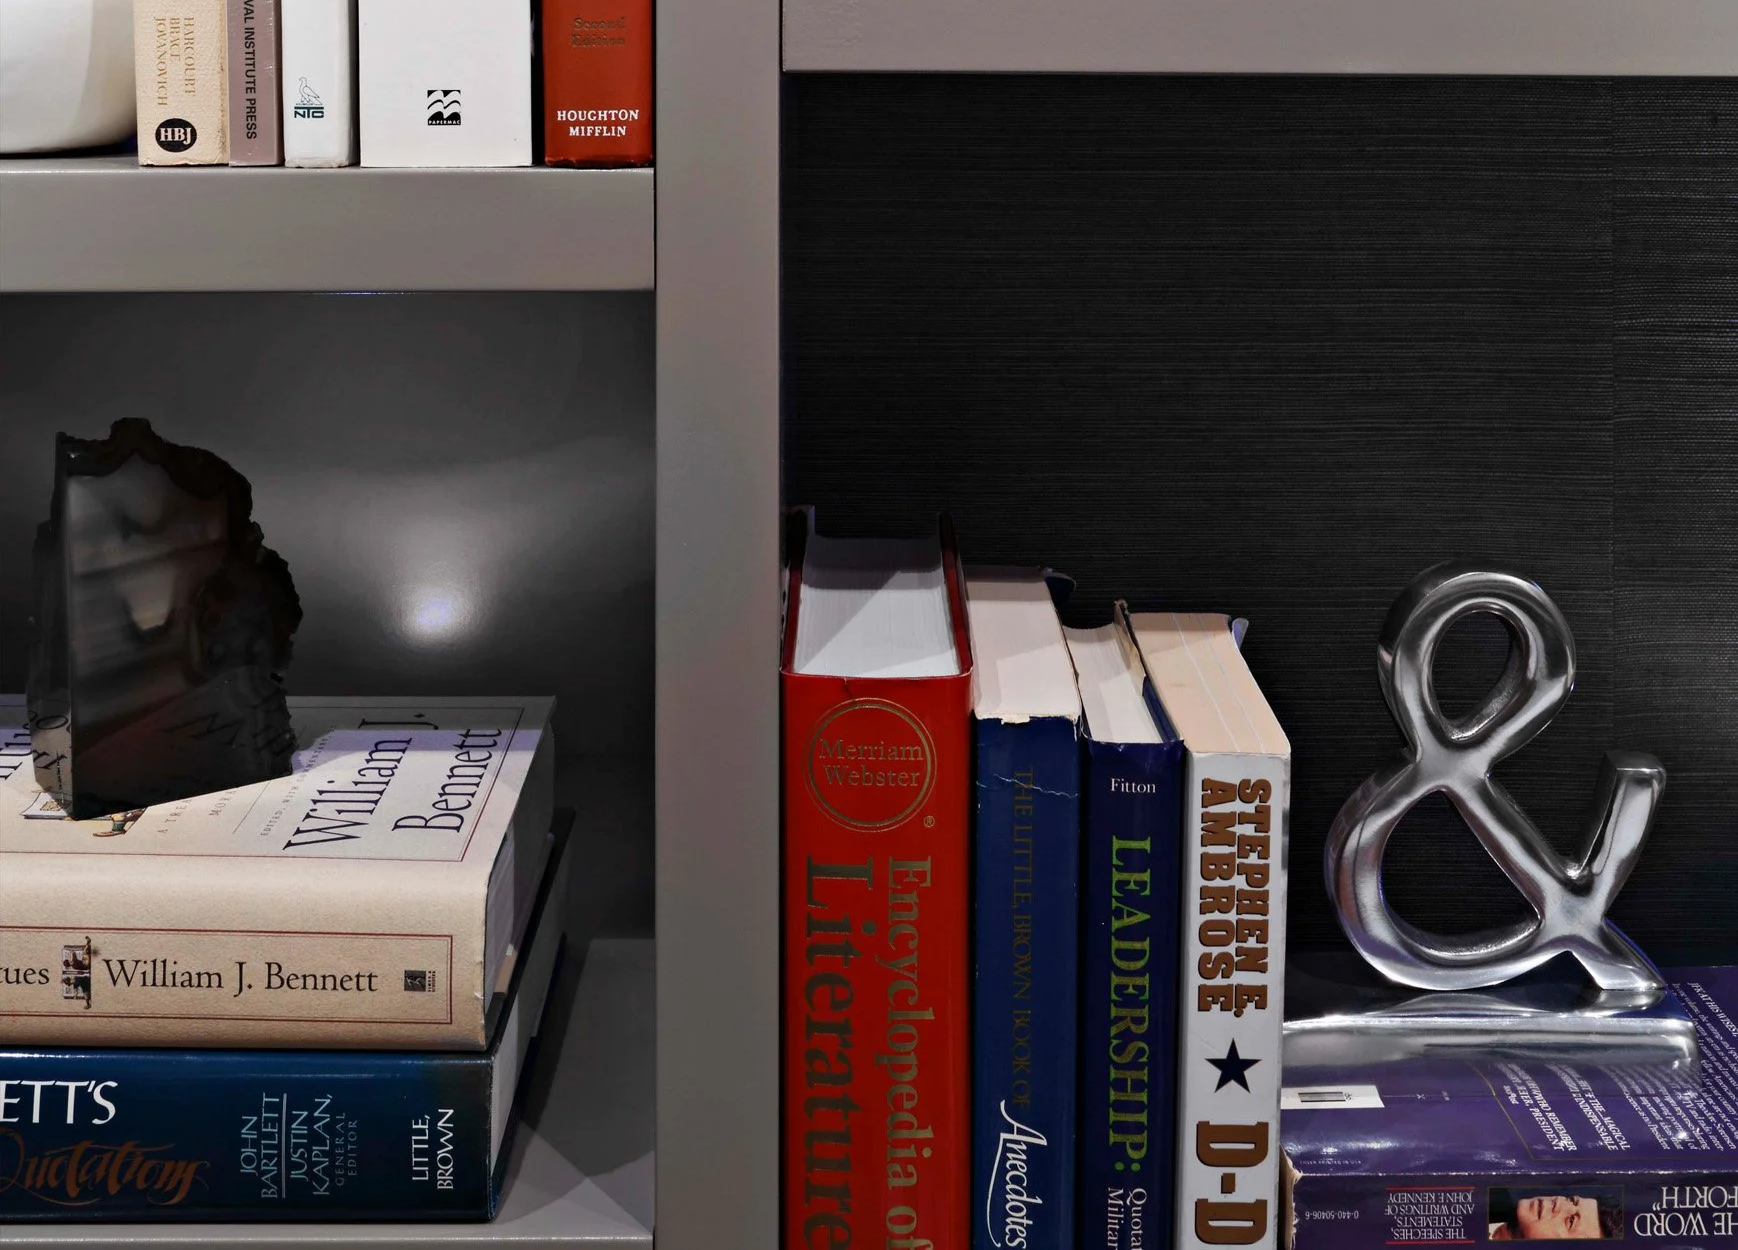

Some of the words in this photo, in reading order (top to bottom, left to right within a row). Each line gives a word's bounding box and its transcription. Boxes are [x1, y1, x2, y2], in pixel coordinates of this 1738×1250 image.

[154, 17, 168, 106] JOVANOVICH
[170, 17, 181, 63] BRACE
[184, 17, 196, 97] HARCOURT
[244, 27, 256, 94] INSTITUTE
[159, 127, 192, 145] HBJ
[246, 98, 257, 139] PRESS
[557, 110, 639, 121] HOUGHTON
[569, 126, 627, 137] MIFFLIN
[819, 739, 924, 761] Merriam
[283, 737, 413, 851] William
[391, 727, 503, 833] Bennett
[823, 764, 922, 787] Webster
[1013, 766, 1033, 817] THE
[1110, 777, 1156, 794] Fitton
[1012, 825, 1033, 908] LITTLE,
[1235, 778, 1272, 973] STEPHEN
[1197, 777, 1238, 1012] AMBROSE
[102, 957, 223, 989] William
[233, 961, 254, 998] J.
[265, 962, 378, 992] Bennett
[1011, 915, 1033, 999] BROWN
[874, 855, 935, 1190] Encyclopedia
[1108, 835, 1151, 1172] LEADERSHIP:
[1233, 984, 1268, 1018] E.
[803, 854, 876, 1250] Literature
[1012, 1010, 1032, 1073] BOOK
[1012, 1079, 1032, 1110] OF
[290, 1111, 308, 1179] JUSTIN
[313, 1094, 333, 1196] KAPLAN,
[1529, 1108, 1565, 1151] PRESIDENT
[1545, 1112, 1577, 1151] REMEMBER
[1574, 1095, 1618, 1150] INDISPENSABLE
[1603, 1117, 1631, 1150] MAGICAL
[1648, 1124, 1671, 1150] President
[1717, 1124, 1737, 1150] Sorensen
[240, 1115, 258, 1176] JOHN
[261, 1092, 280, 1199] BARTLETT
[336, 1111, 346, 1186] GENERAL
[348, 1119, 358, 1177] EDITOR
[412, 1114, 431, 1181] LITTLE,
[436, 1108, 454, 1190] BROWN
[987, 1100, 1048, 1249] Anecdotes
[1389, 1191, 1436, 1202] KENNEDY
[1448, 1189, 1473, 1202] JOHN
[886, 1205, 934, 1250] of
[1305, 1209, 1360, 1220] 0-440-50406-6
[1384, 1204, 1399, 1215] OF
[1396, 1215, 1463, 1228] STATEMENTS,
[1400, 1204, 1449, 1215] WRITINGS
[1450, 1204, 1475, 1215] AND
[1634, 1212, 1709, 1237] WORD
[1390, 1227, 1444, 1241] SPEECHES,
[1446, 1228, 1466, 1240] THE
